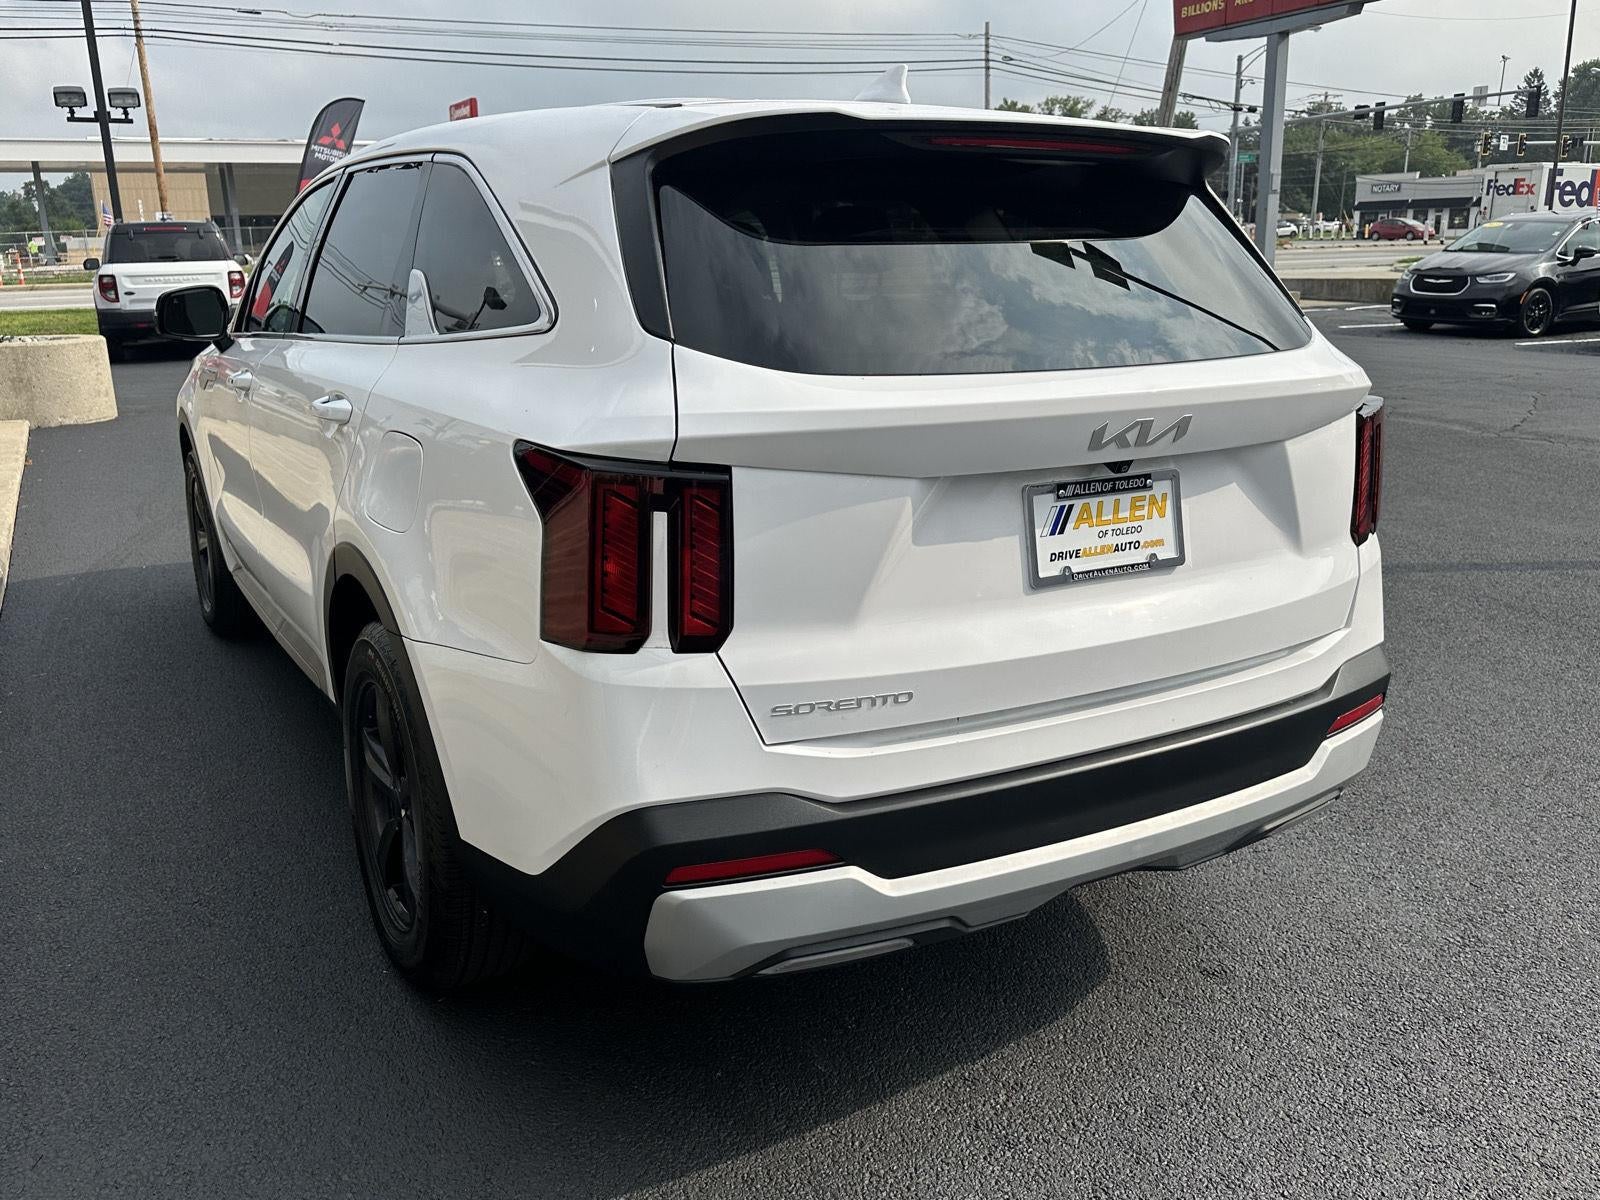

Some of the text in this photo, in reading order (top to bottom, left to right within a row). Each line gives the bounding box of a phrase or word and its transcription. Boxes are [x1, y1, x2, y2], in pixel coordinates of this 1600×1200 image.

[1181, 0, 1225, 18] BILLIONS
[1372, 184, 1399, 193] NOTARY
[1486, 177, 1536, 196] FedEx
[1545, 168, 1600, 208] Fed
[1087, 414, 1192, 451] KIA
[1074, 478, 1145, 495] ALLEN OF TOLEDO
[1073, 493, 1168, 530] ALLEN
[1098, 525, 1143, 539] OF TOLEDO
[770, 690, 914, 717] SORENTO
